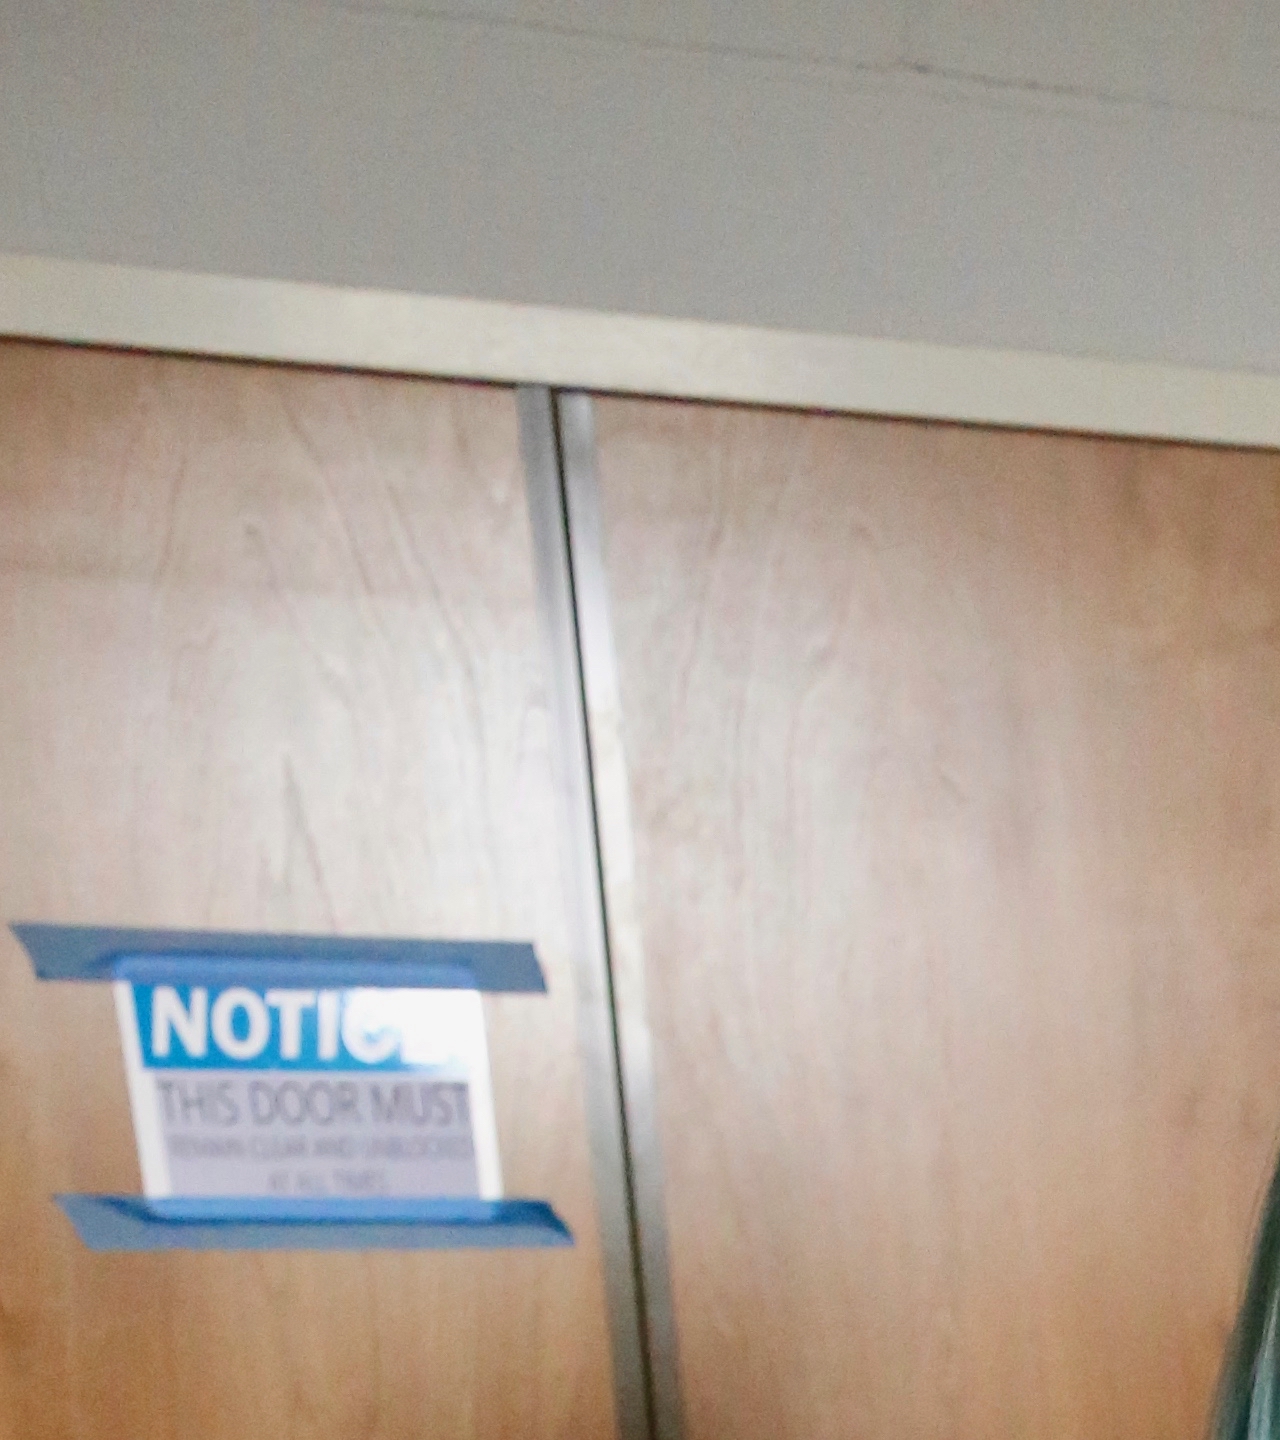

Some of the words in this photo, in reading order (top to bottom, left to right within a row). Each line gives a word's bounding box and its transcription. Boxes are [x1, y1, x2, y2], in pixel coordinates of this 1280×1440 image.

[152, 987, 450, 1064] NOTIC
[158, 1081, 239, 1126] THIS
[248, 1080, 361, 1126] DOOR
[369, 1081, 469, 1126] MUST
